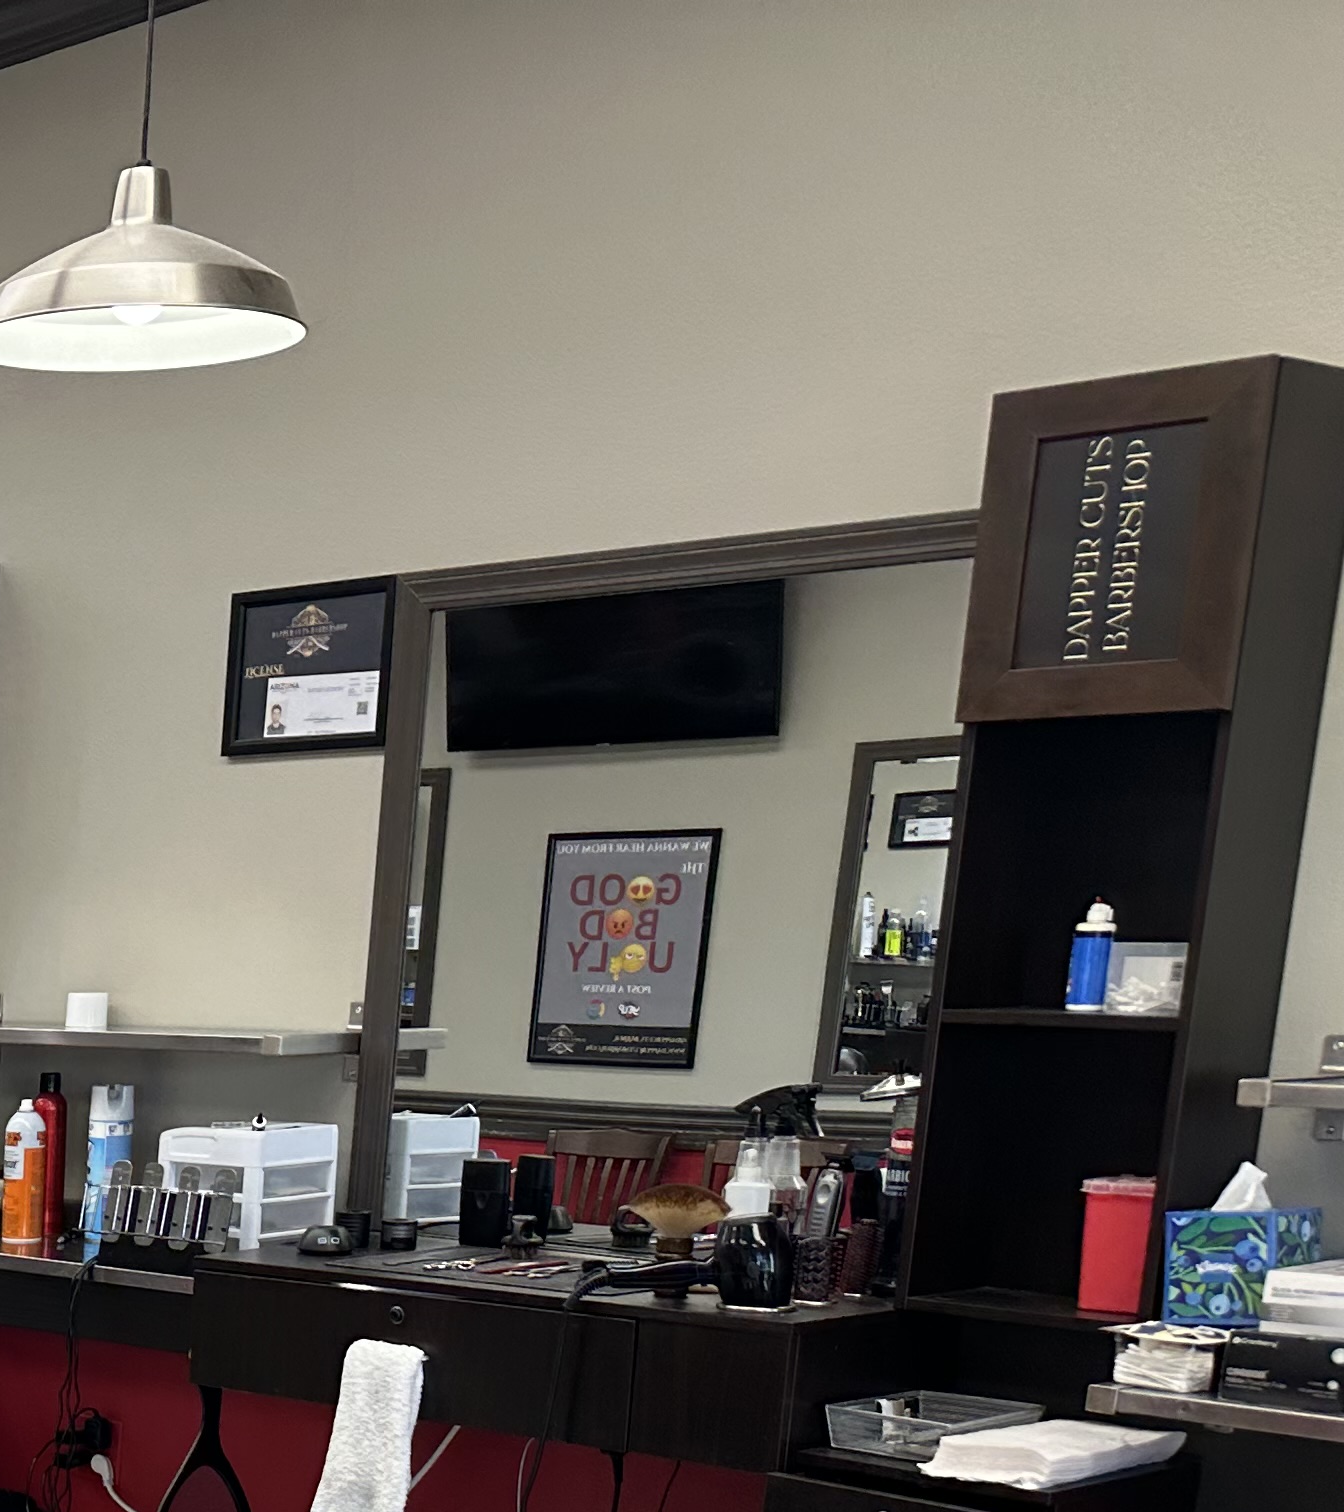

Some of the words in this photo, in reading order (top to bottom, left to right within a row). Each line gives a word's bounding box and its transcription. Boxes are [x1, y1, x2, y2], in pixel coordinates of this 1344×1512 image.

[1079, 435, 1113, 529] CUTS
[1063, 537, 1102, 661] DAPPER
[1102, 438, 1152, 652] BARBERSHOP
